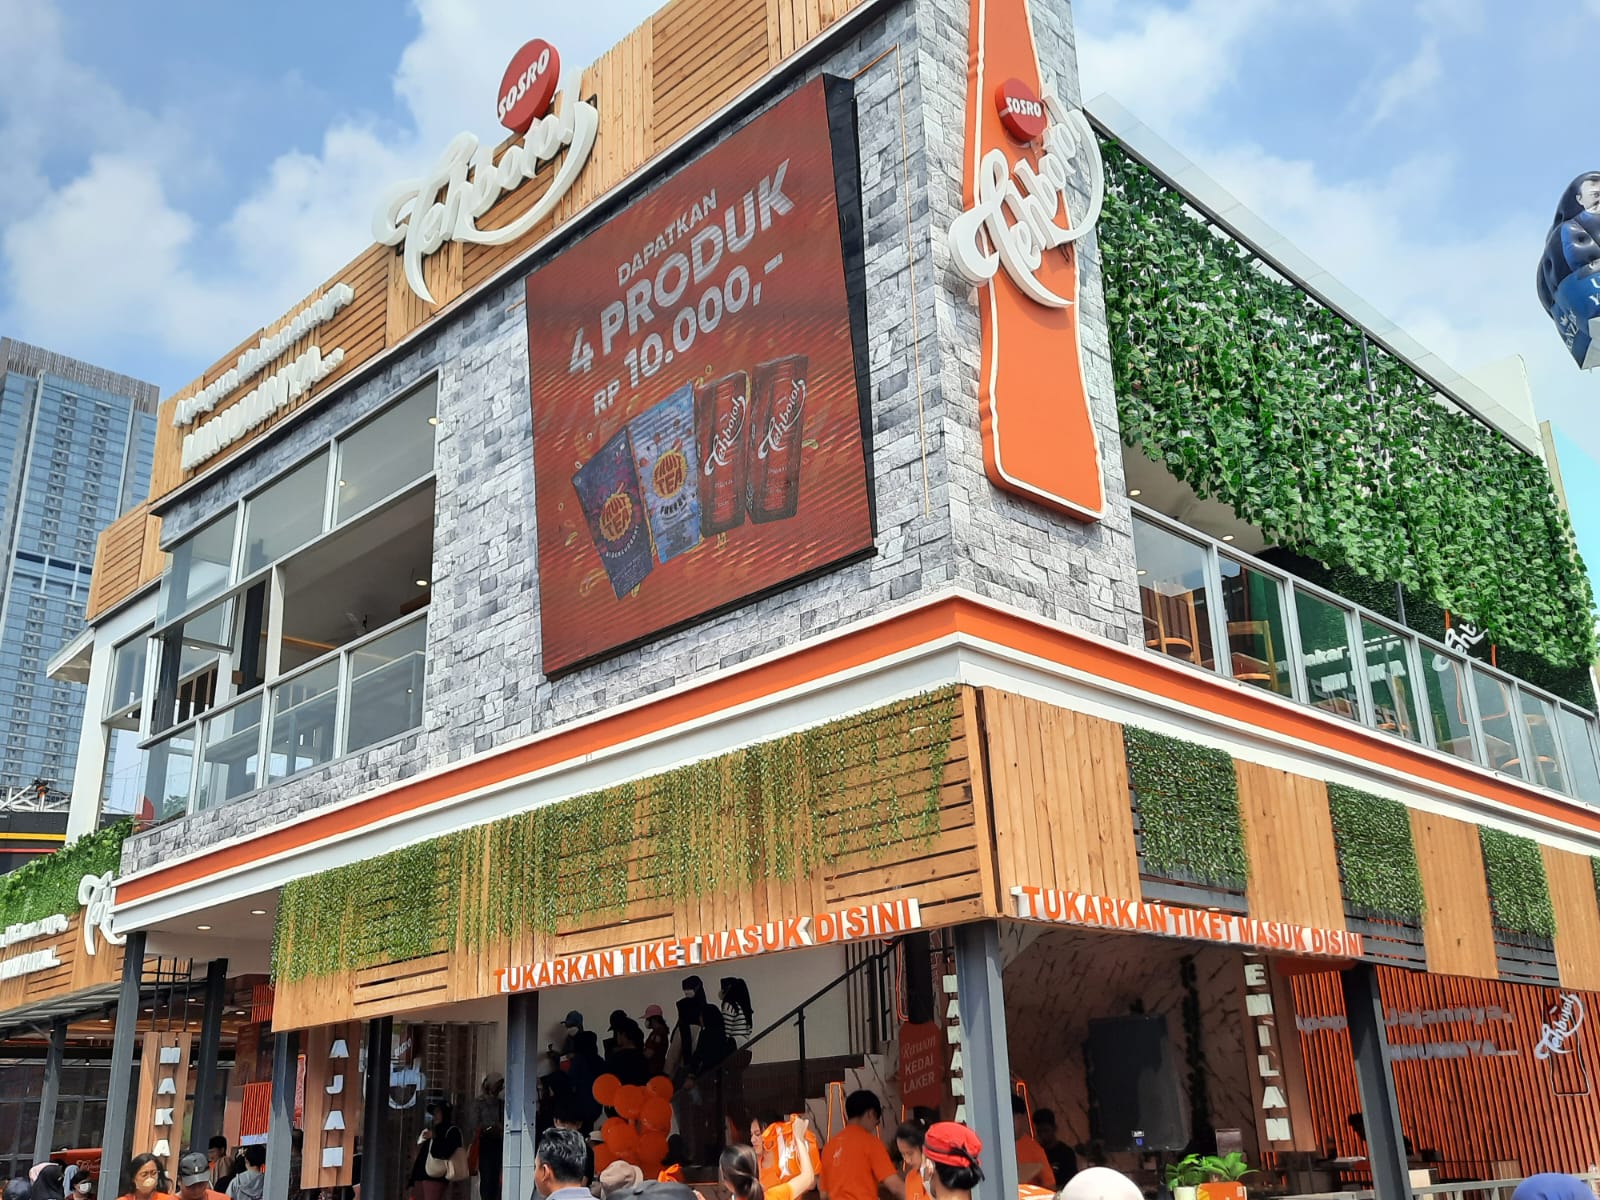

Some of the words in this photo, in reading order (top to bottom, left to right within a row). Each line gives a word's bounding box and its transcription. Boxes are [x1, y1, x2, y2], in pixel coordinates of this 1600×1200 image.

[498, 48, 550, 122] SOSRO
[1005, 96, 1042, 118] SOSRO
[616, 188, 717, 287] DAPATKAN
[568, 327, 595, 374] 4
[601, 158, 795, 356] PRODUK
[593, 379, 620, 416] RP
[623, 252, 784, 389] 10.000,-
[653, 452, 683, 481] FRUIT
[655, 470, 684, 496] TEA
[601, 494, 628, 524] FRUIT
[605, 511, 630, 539] TEA
[493, 950, 616, 993] TUKARKAN
[620, 936, 699, 976] TIKET
[701, 916, 812, 960] MASUK
[814, 898, 919, 945] DISINI
[1020, 885, 1169, 933] TUKARKAN
[1169, 907, 1233, 942] TIKET
[1237, 917, 1307, 952] MASUK
[1310, 927, 1365, 957] DISINI
[904, 1054, 935, 1077] KEDAI
[1242, 952, 1292, 1141] EMILAN
[902, 1070, 937, 1095] LAKER
